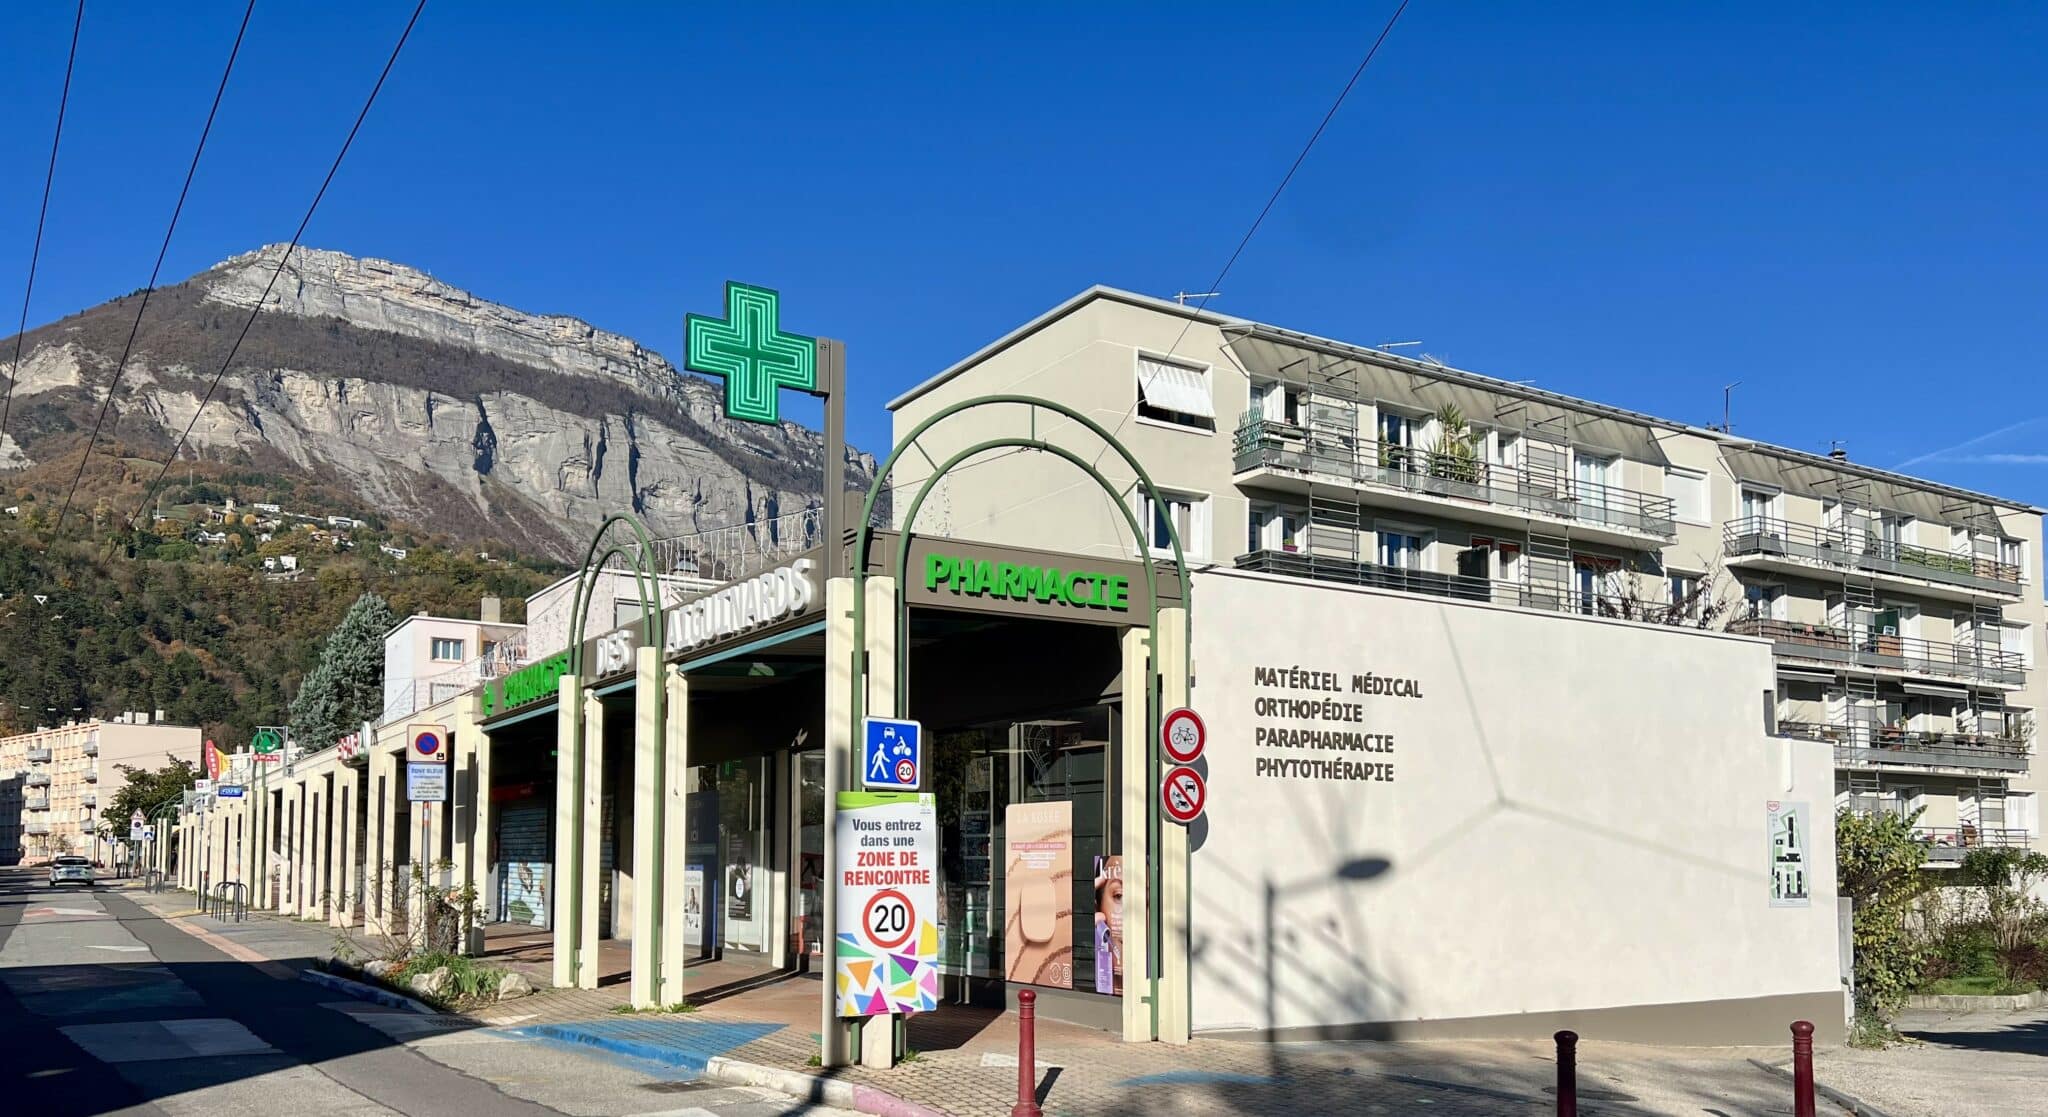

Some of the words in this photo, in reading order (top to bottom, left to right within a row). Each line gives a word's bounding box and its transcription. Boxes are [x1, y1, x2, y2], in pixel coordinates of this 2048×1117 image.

[925, 552, 1128, 609] PHARMACIE
[596, 630, 634, 676] DES
[666, 558, 817, 653] AIGUINARDS
[1254, 665, 1342, 692] MATÉRIEL
[1352, 672, 1423, 698] MÉDICAL
[1254, 697, 1363, 722] ORTHOPÉDIE
[1255, 727, 1394, 753] PARAPHARMACIE
[900, 766, 911, 776] 20
[1256, 757, 1394, 782] PHYTOTHÉRAPIE
[852, 818, 882, 831] Vous
[885, 819, 922, 831] entrez
[860, 834, 890, 847] dans
[893, 836, 914, 846] une
[857, 851, 895, 867] ZONE
[899, 851, 918, 866] DE
[844, 869, 930, 886] RENCONTRE
[874, 904, 906, 933] 20
